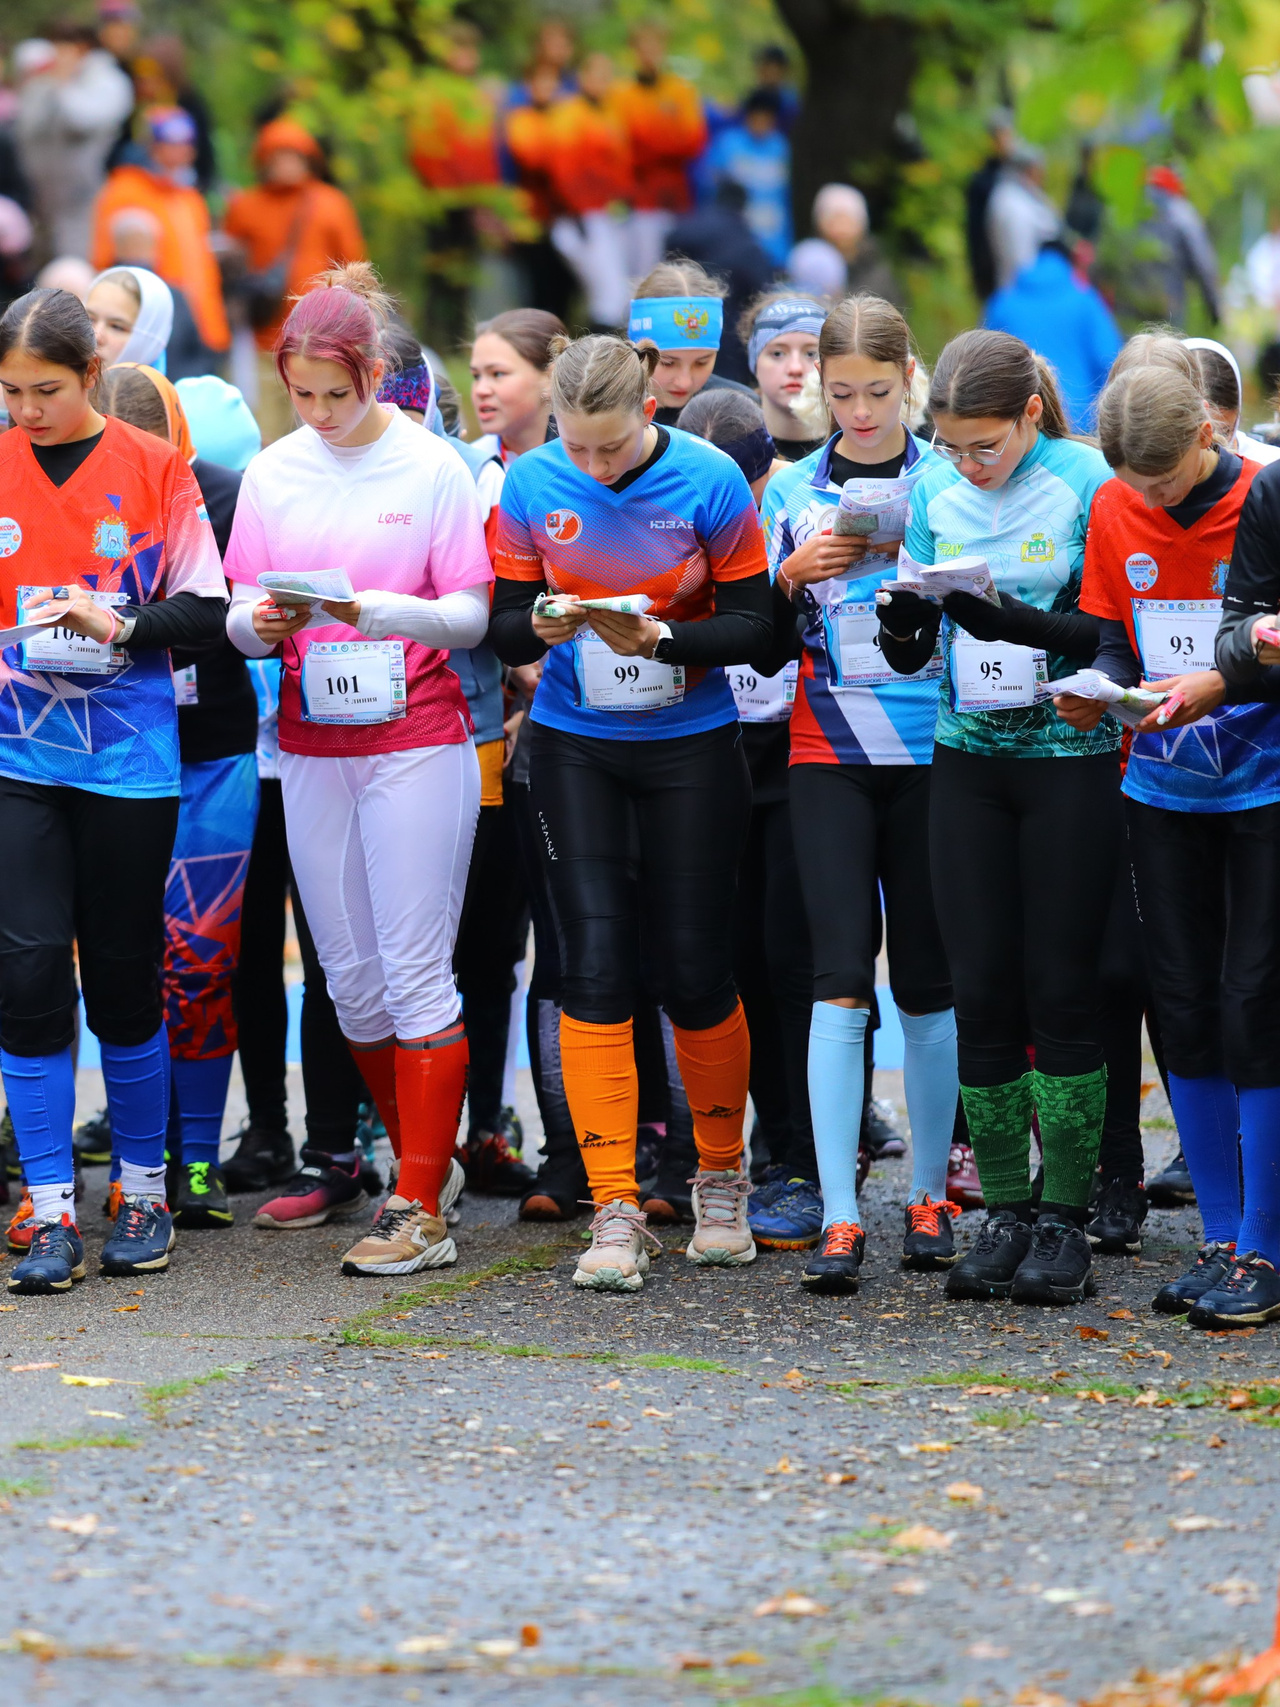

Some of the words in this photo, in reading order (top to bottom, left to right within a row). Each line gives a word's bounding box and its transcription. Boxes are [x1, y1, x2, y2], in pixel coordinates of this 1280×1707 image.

[378, 512, 413, 525] LØPE
[74, 646, 100, 654] линия
[1170, 636, 1194, 655] 93
[614, 664, 640, 685] 99
[980, 661, 1003, 680] 95
[326, 675, 360, 695] 101
[636, 685, 663, 694] линия
[991, 701, 1026, 709] СОРЕВНОВАНИЯ
